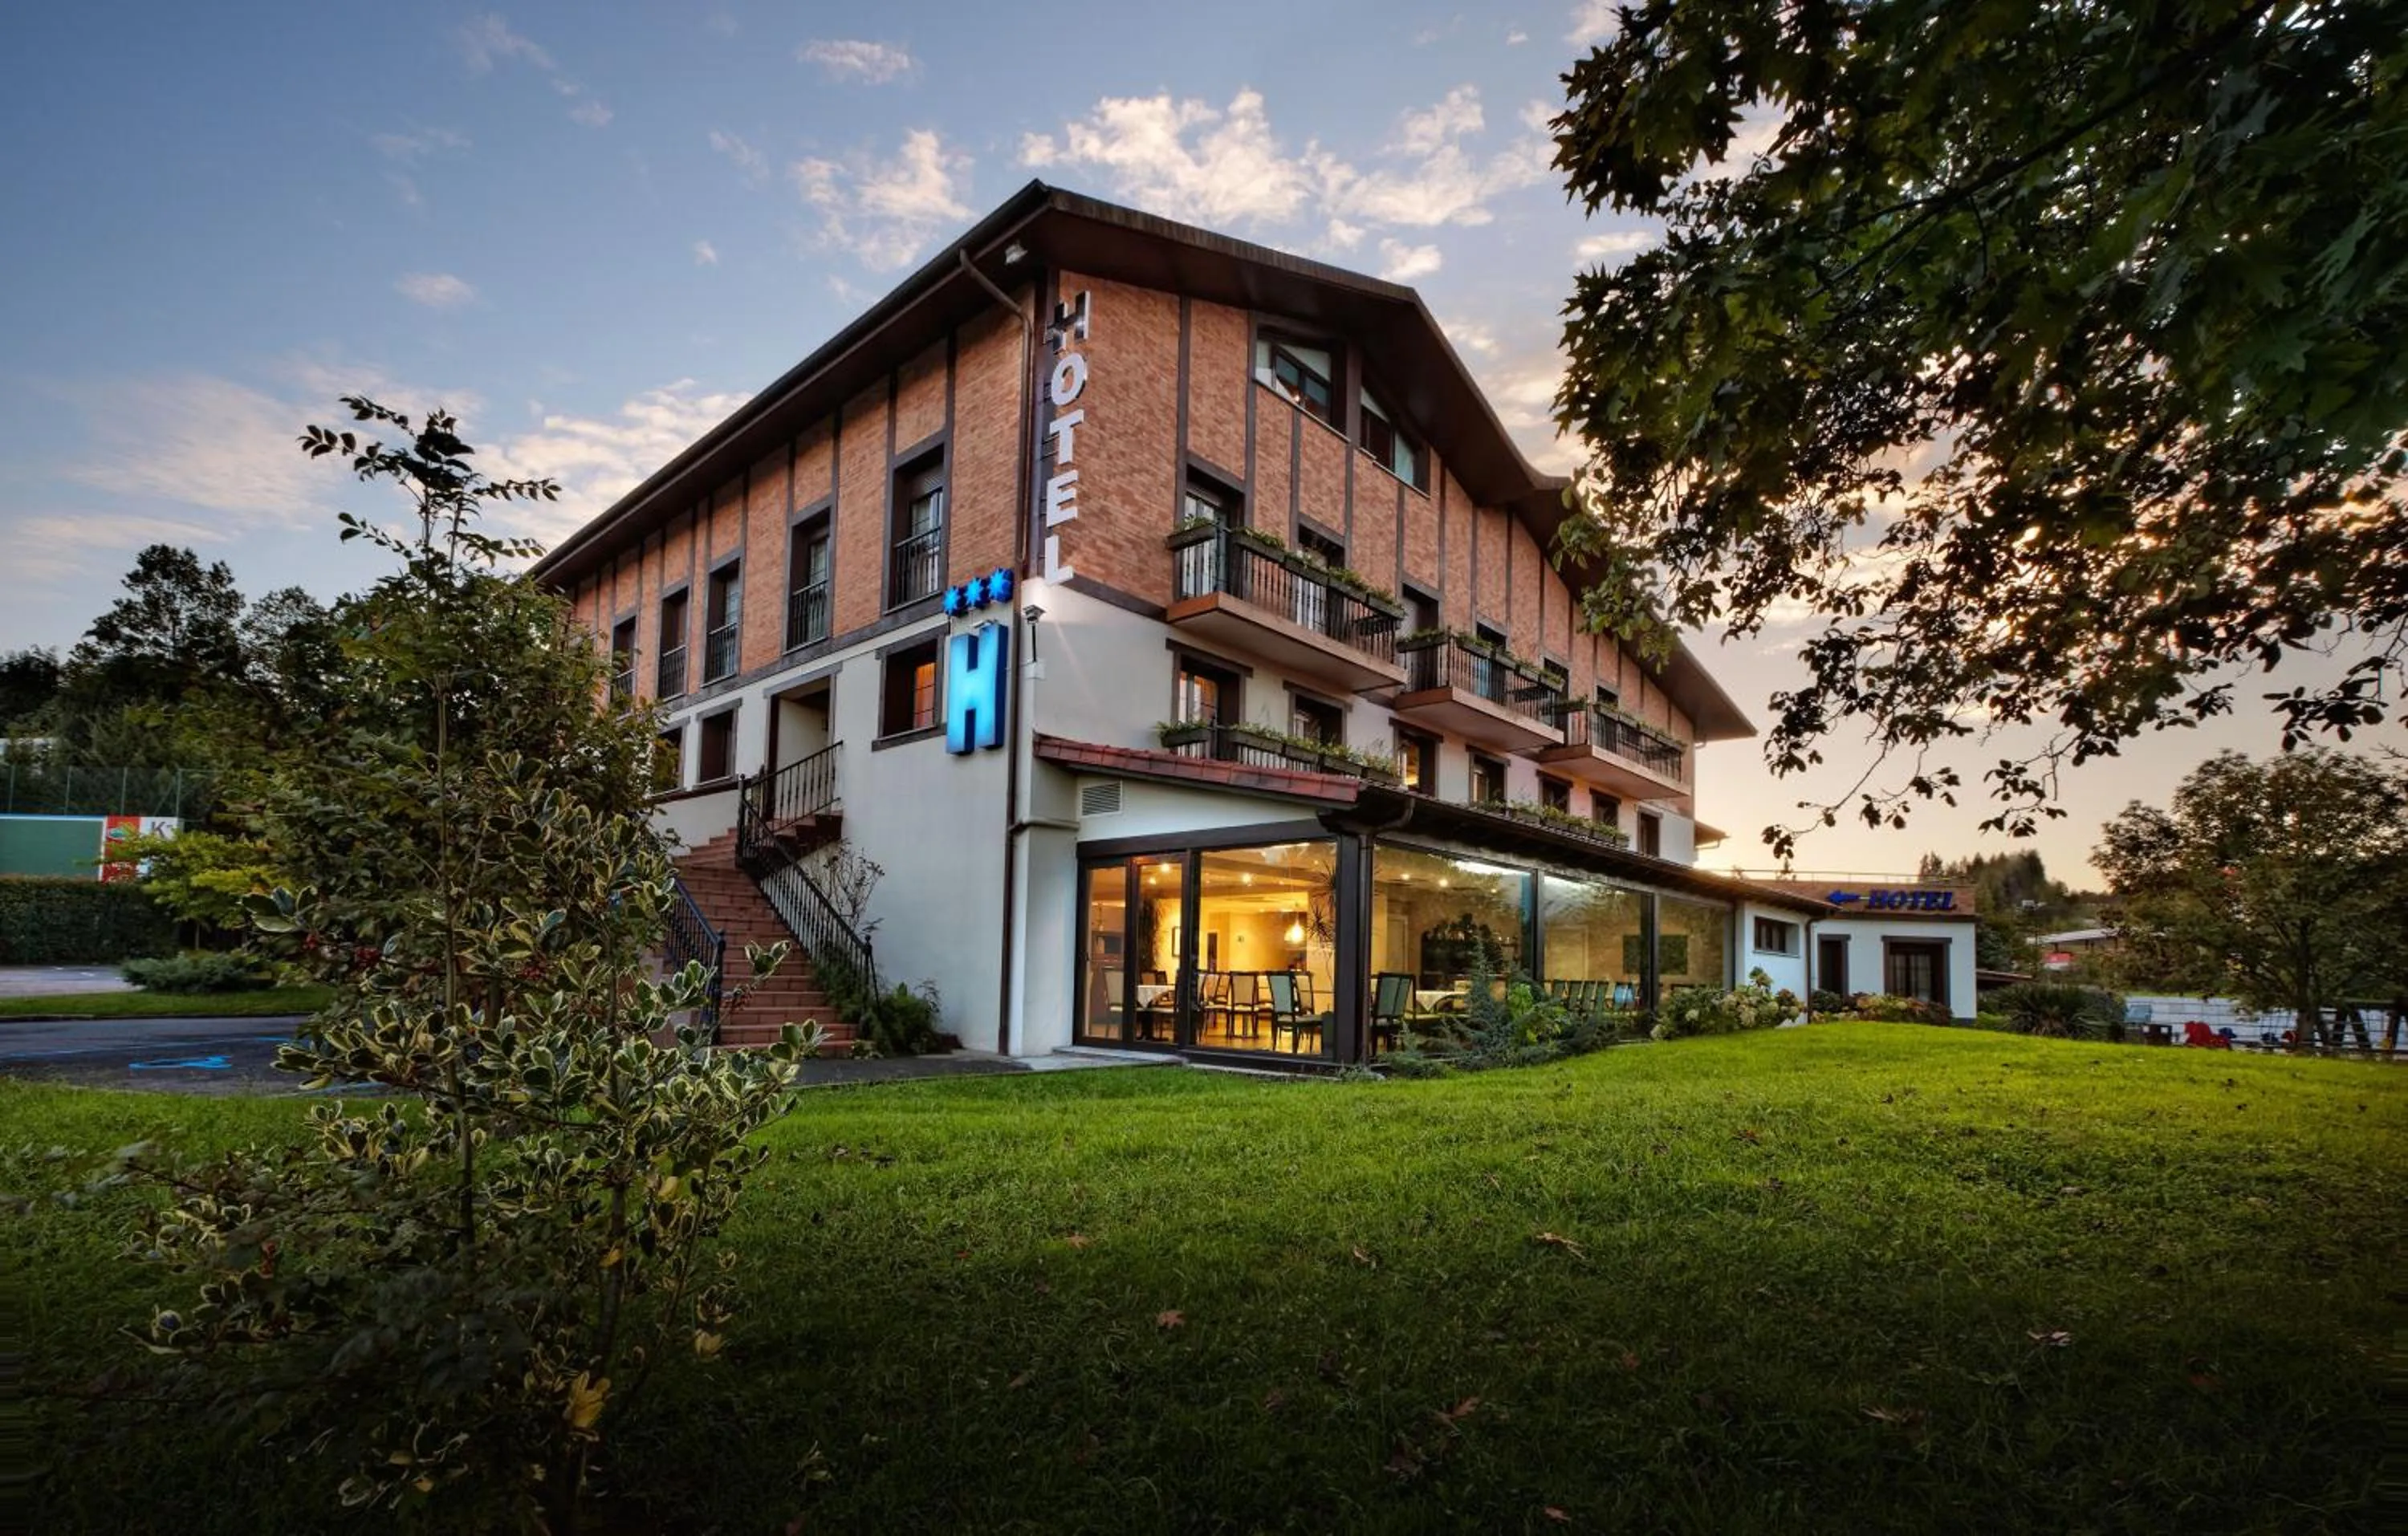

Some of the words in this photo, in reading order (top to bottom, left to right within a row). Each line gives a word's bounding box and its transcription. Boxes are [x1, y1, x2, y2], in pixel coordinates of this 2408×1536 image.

[1045, 291, 1090, 587] HOTEL
[946, 624, 1008, 755] H
[1867, 889, 1957, 911] HOTEL
